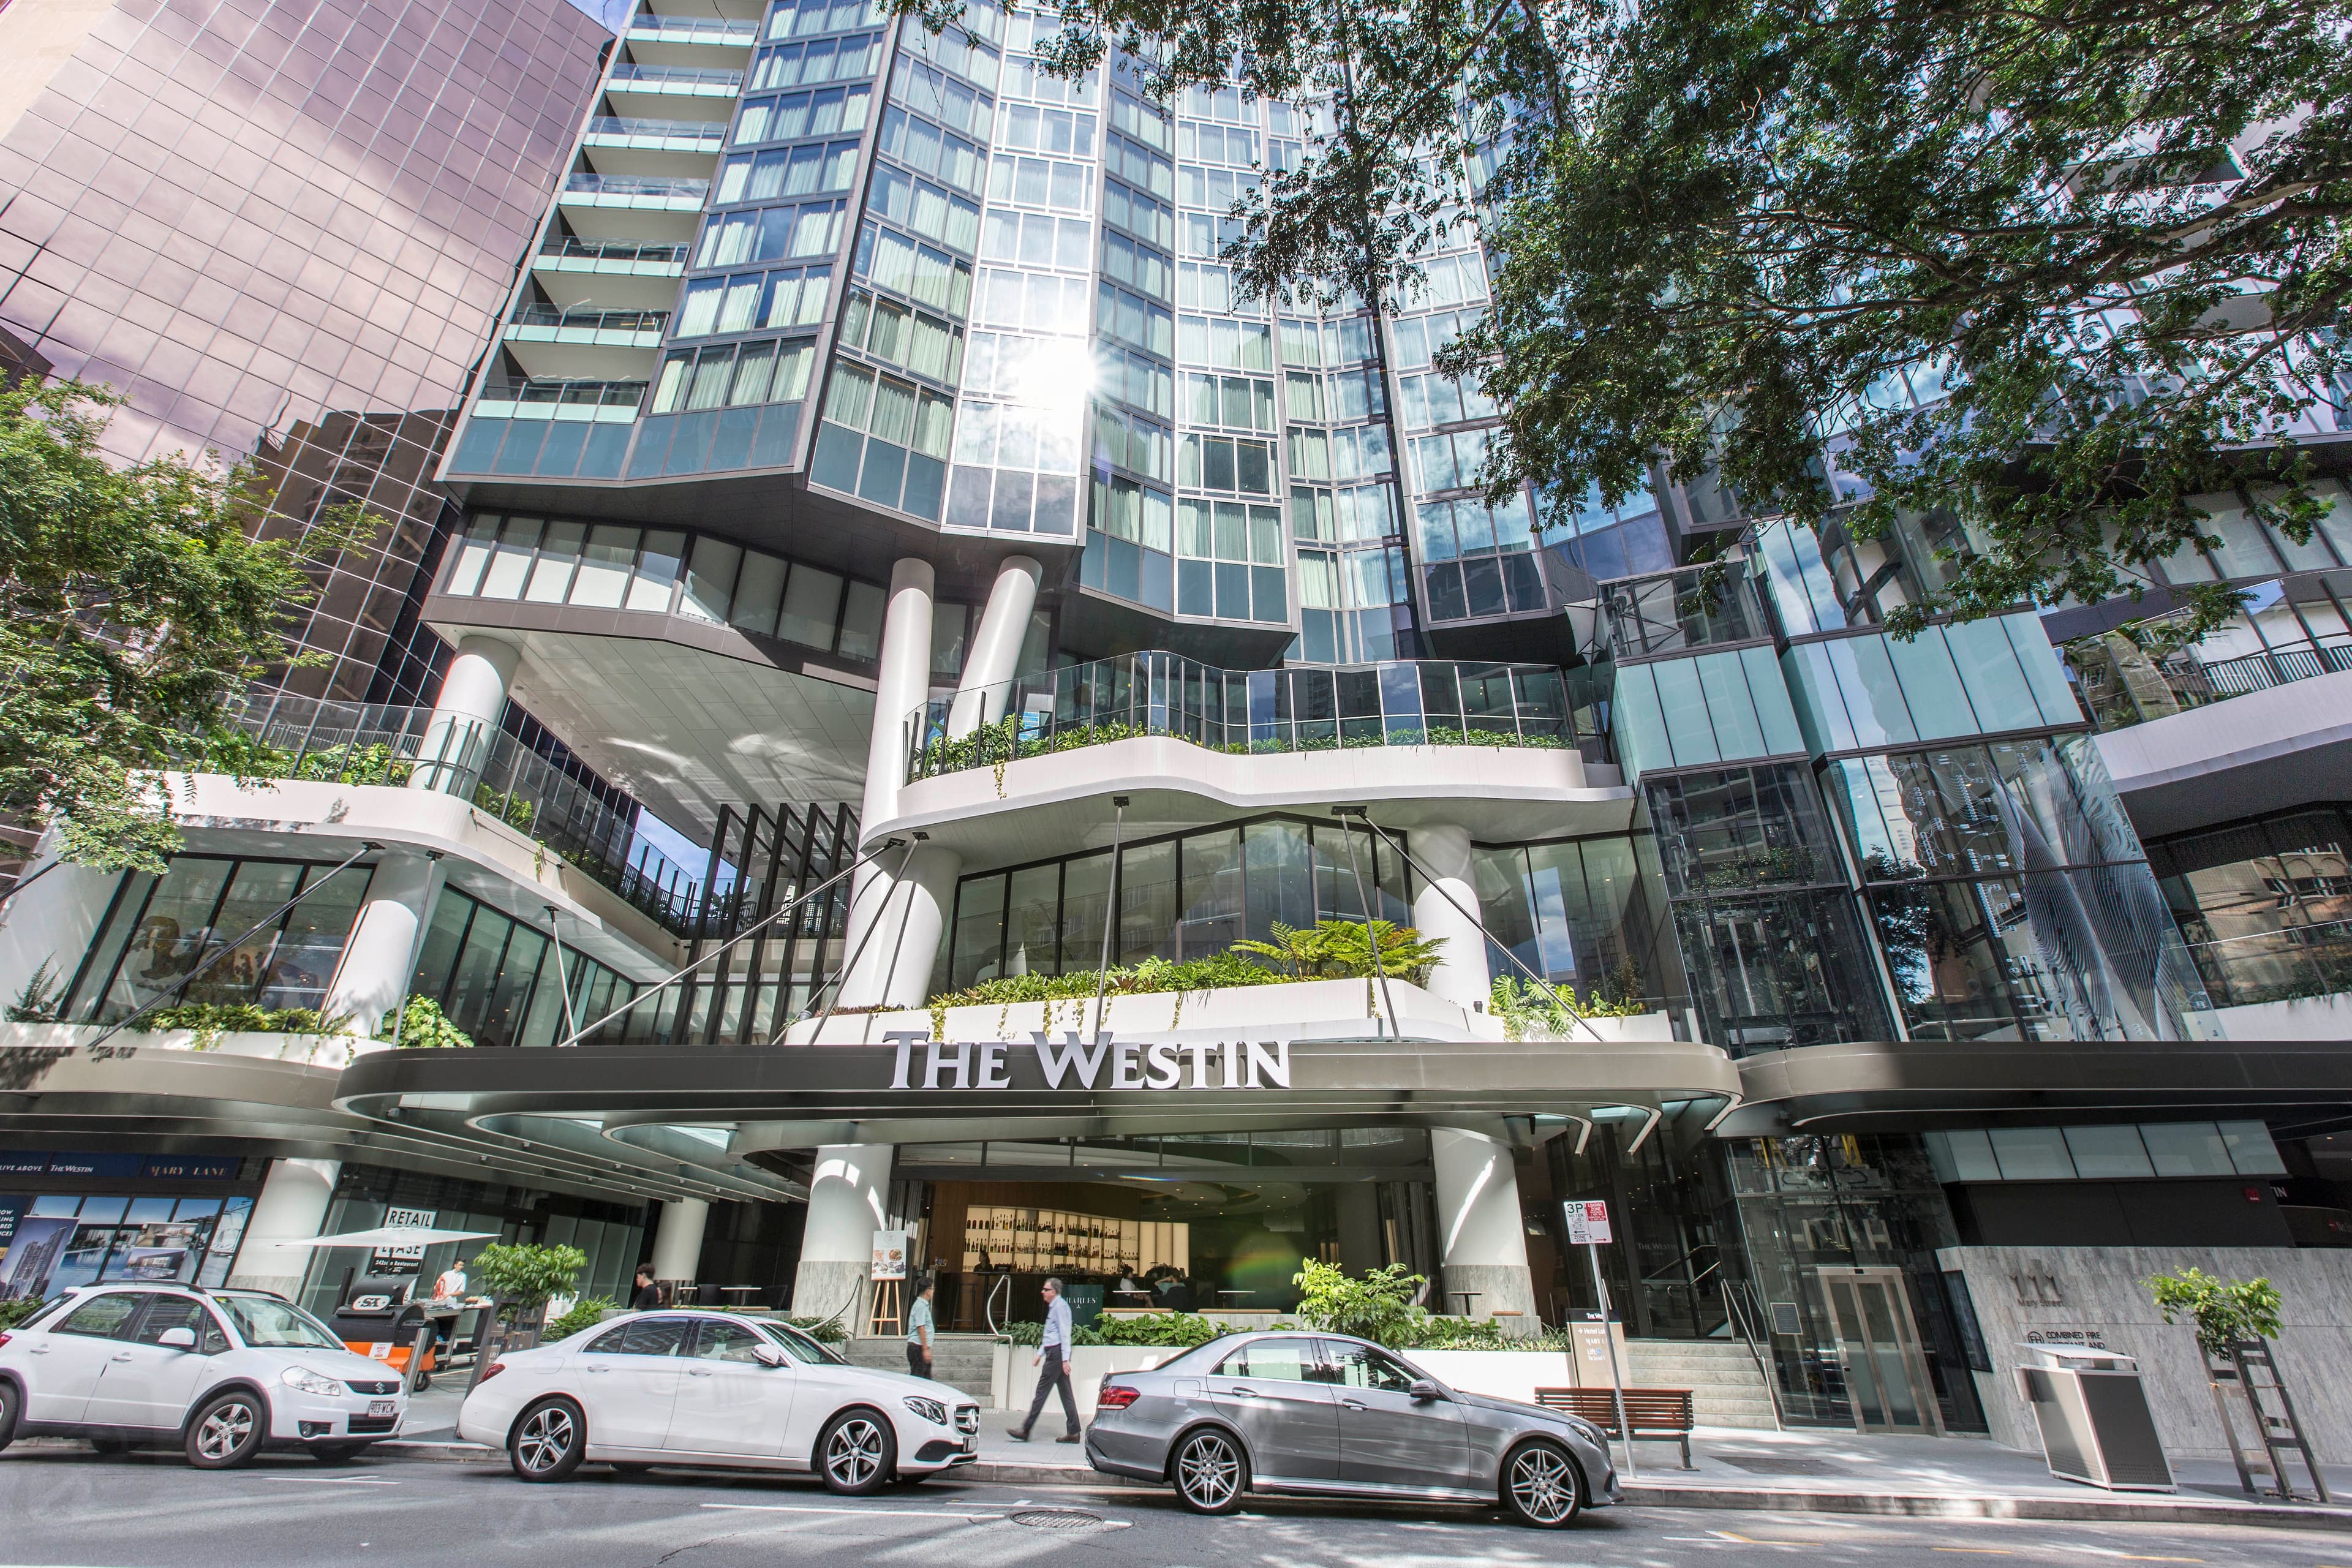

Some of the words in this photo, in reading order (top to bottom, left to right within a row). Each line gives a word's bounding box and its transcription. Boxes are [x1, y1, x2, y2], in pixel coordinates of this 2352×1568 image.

[883, 1030, 1012, 1090] THE
[1029, 1030, 1292, 1090] WESTIN
[151, 1166, 186, 1177] MARY
[192, 1167, 228, 1176] LANE
[1567, 1204, 1583, 1213] 3P
[388, 1210, 431, 1227] RETAIL
[382, 1245, 421, 1254] LASE
[2018, 1299, 2038, 1308] Mary
